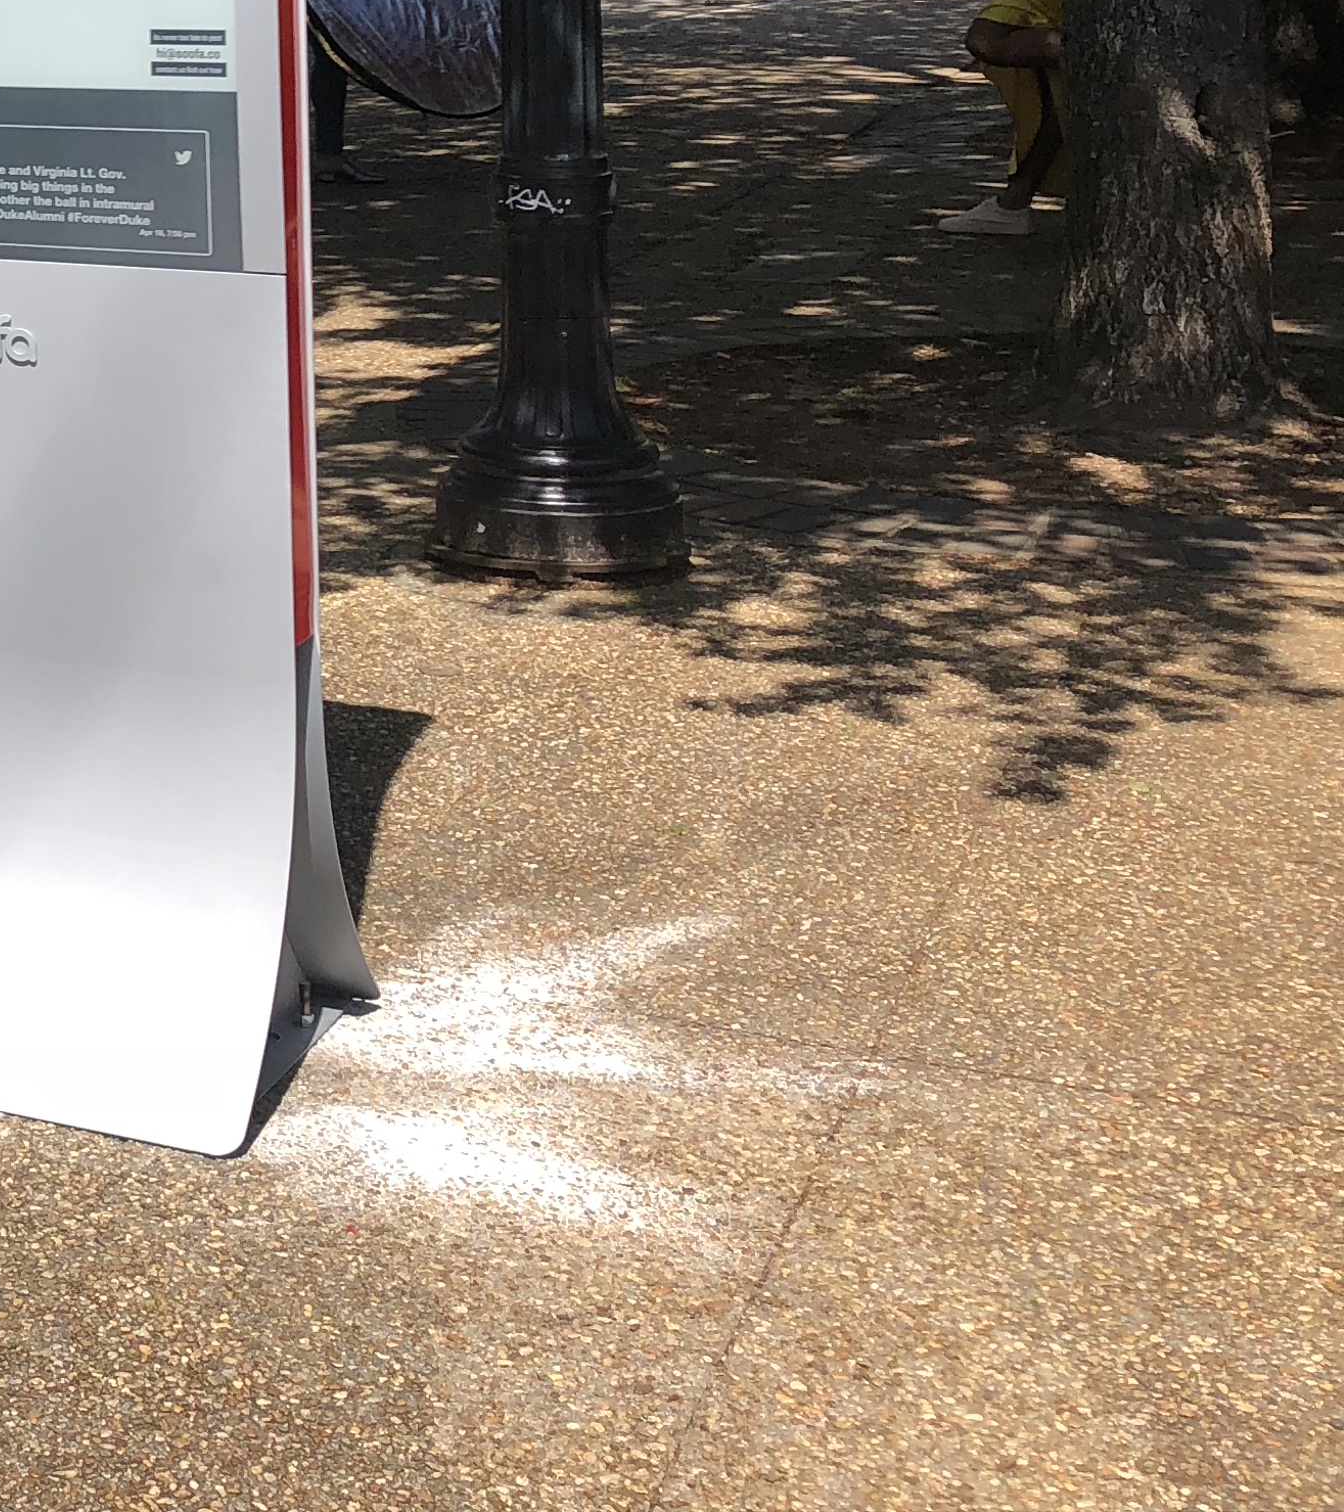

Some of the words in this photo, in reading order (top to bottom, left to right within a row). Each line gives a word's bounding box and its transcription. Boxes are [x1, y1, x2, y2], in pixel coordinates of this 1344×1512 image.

[8, 166, 31, 176] and
[33, 166, 77, 179] Virginia
[80, 168, 97, 178] Lt.
[99, 168, 127, 180] Gov.
[20, 181, 39, 193] big
[42, 182, 79, 194] things
[81, 183, 92, 192] in
[95, 184, 115, 194] the
[0, 195, 30, 205] other
[33, 196, 52, 207] the
[55, 197, 76, 207] ball
[79, 198, 90, 208] in
[93, 199, 154, 211] intramural
[67, 211, 151, 226] #ForeverDuke
